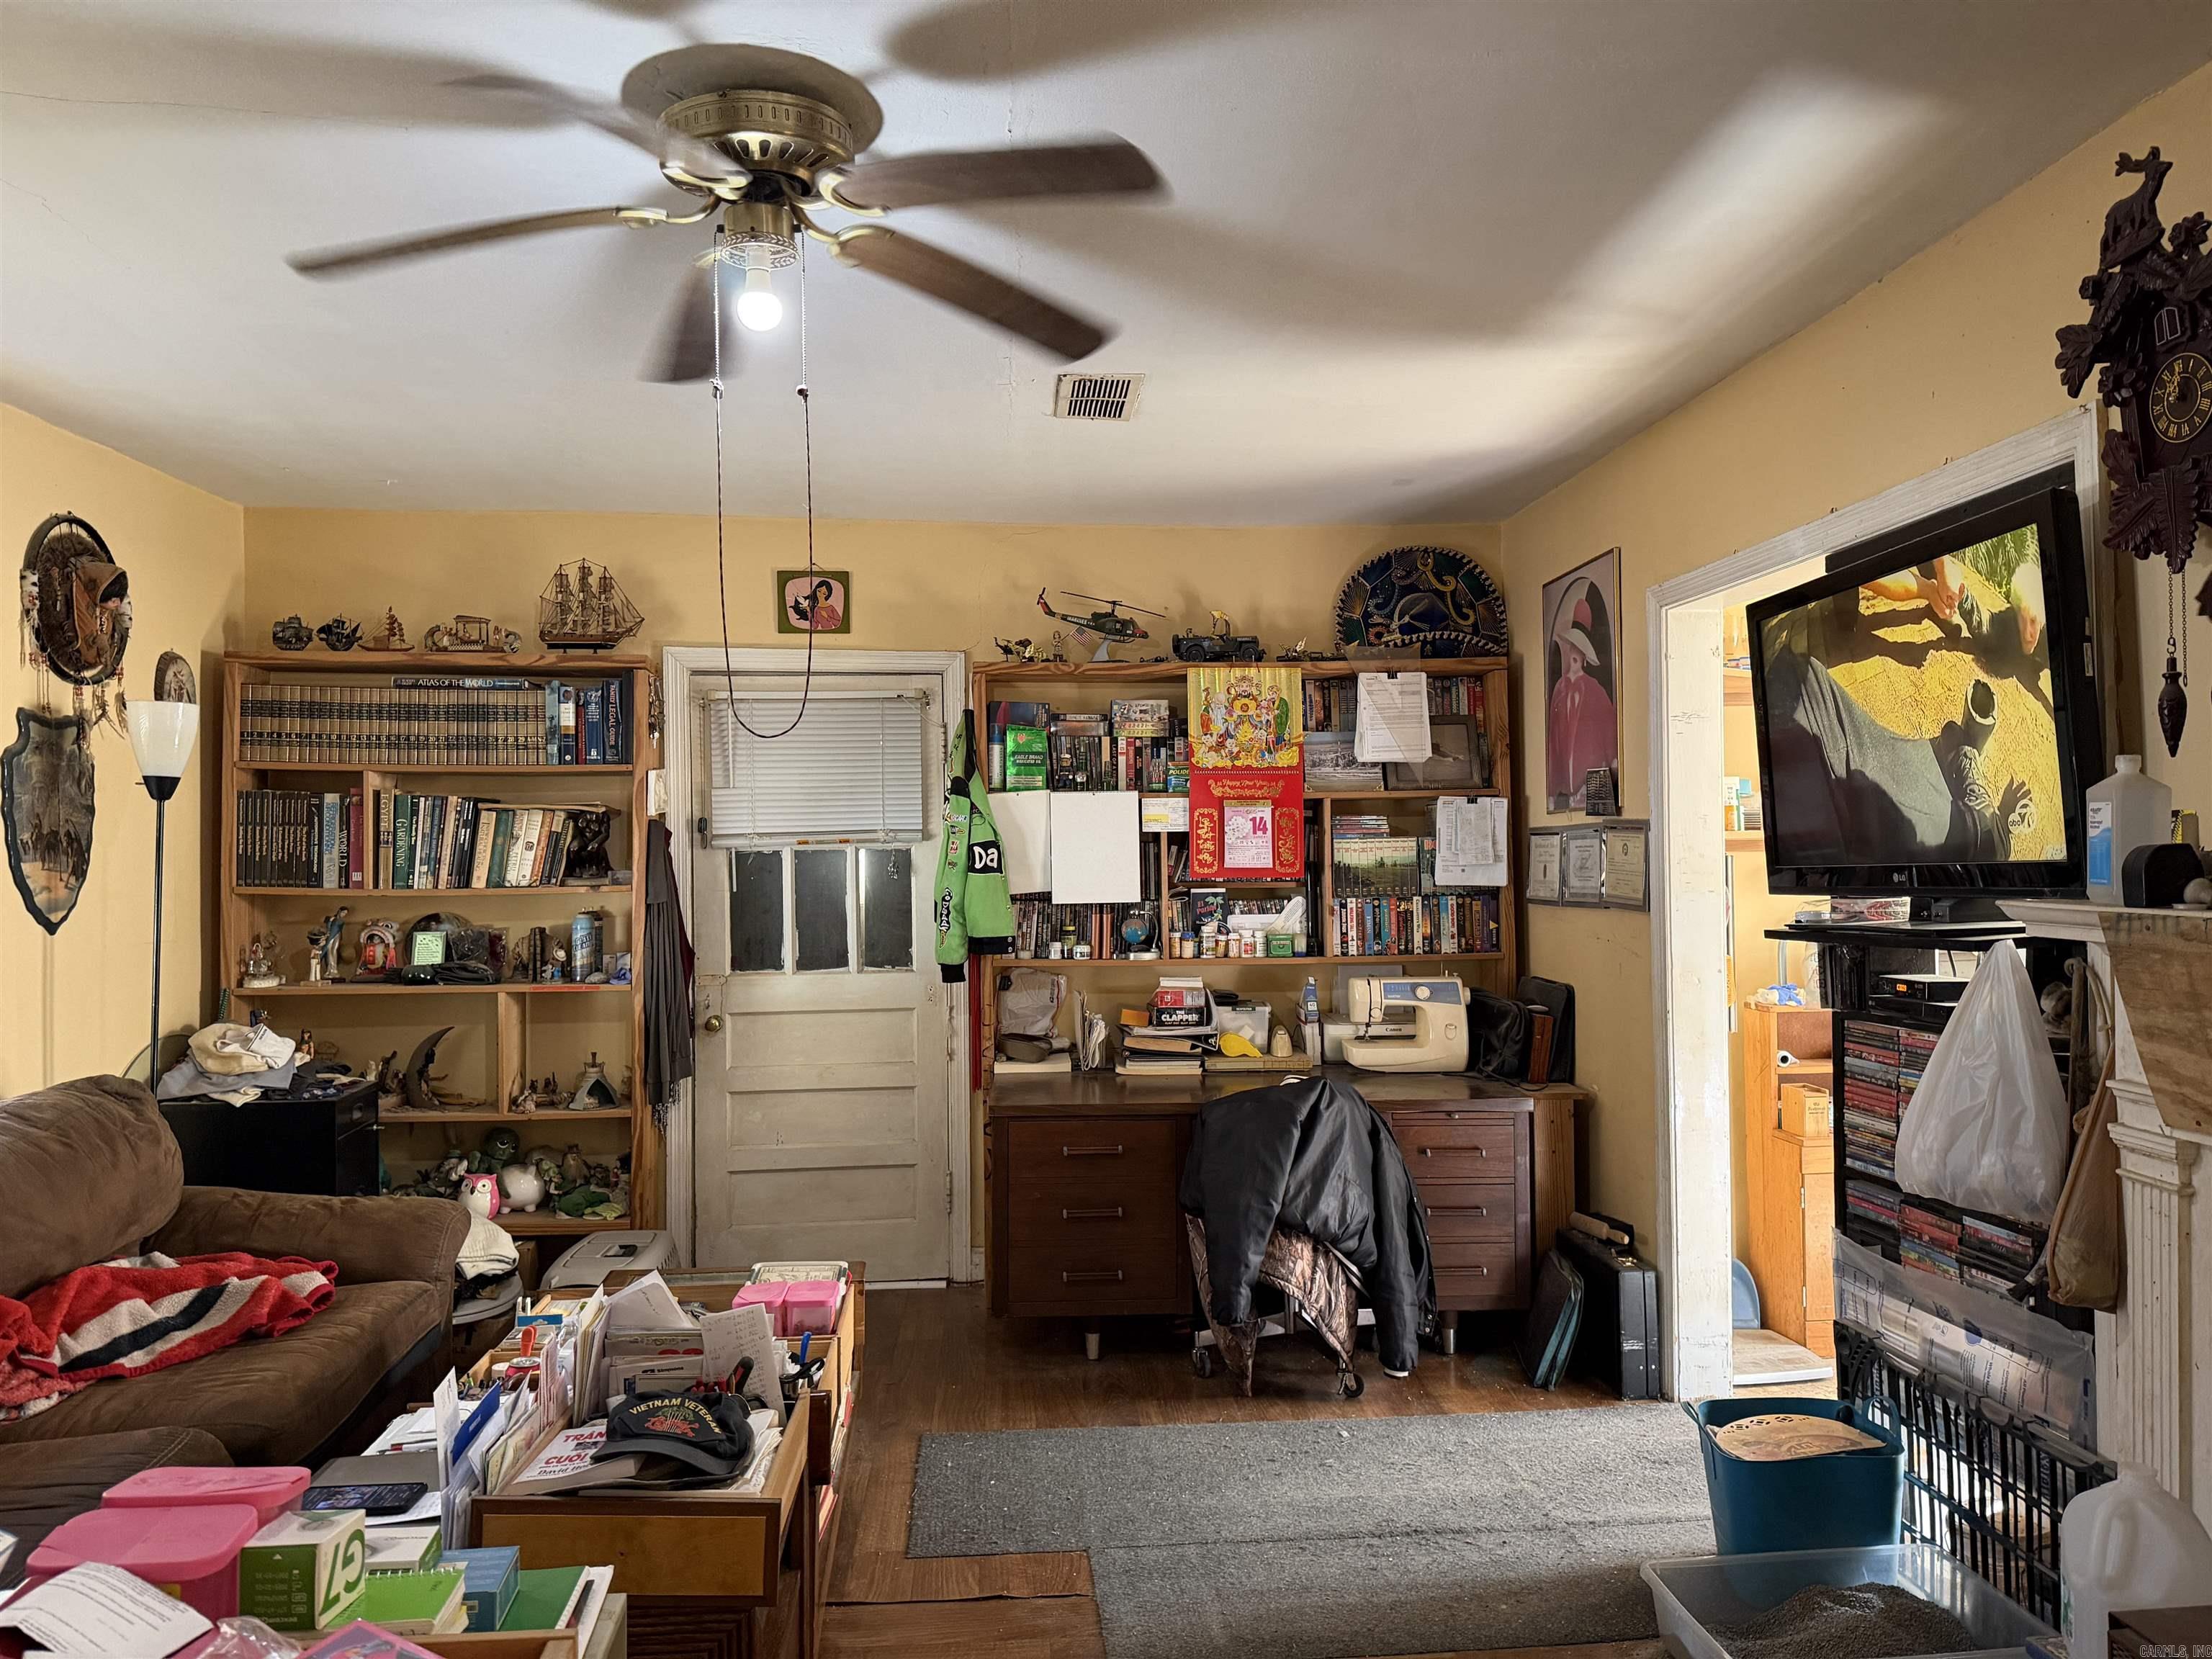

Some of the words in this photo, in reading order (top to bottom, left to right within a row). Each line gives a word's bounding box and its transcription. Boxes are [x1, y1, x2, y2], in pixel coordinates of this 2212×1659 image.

[380, 794, 389, 828] EGYPT
[1249, 816, 1268, 835] 14
[2009, 818, 2020, 827] abc
[395, 819, 408, 867] GARDENING
[629, 1398, 681, 1415] VIETNAM
[684, 1399, 722, 1434] VETERAN
